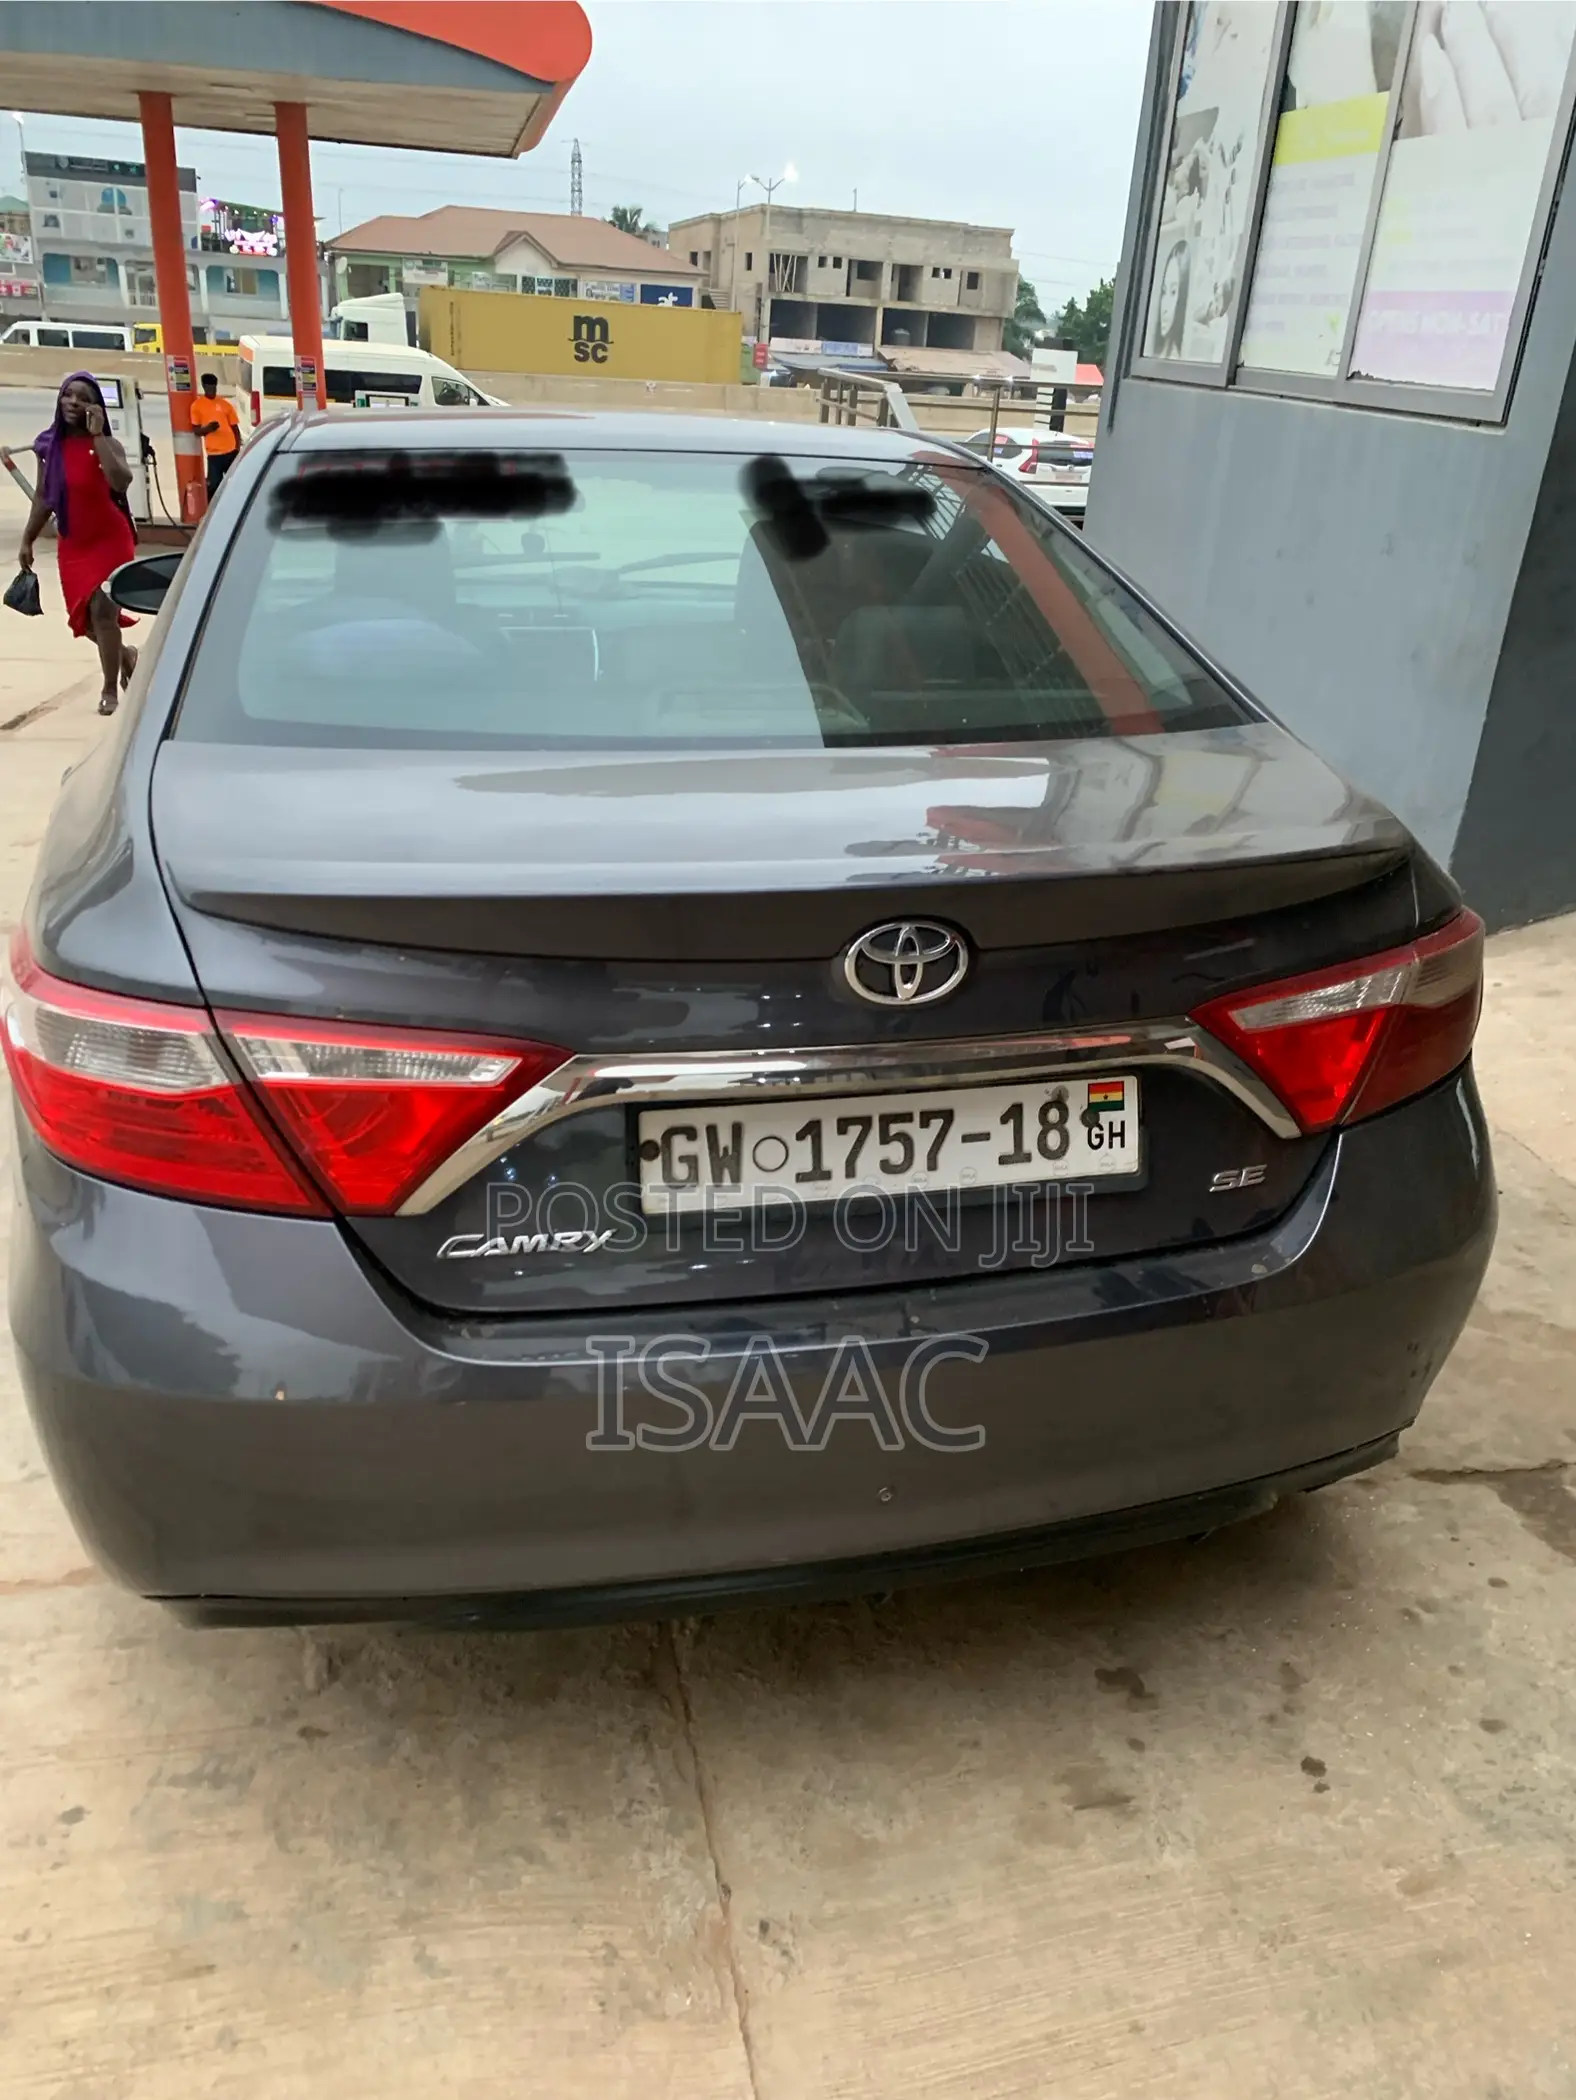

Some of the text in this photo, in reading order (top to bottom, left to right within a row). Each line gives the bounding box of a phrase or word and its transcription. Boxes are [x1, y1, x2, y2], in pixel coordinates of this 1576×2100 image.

[660, 1101, 1071, 1189] GW 1757-18
[1086, 1119, 1126, 1151] GH
[1209, 1164, 1267, 1192] SE
[436, 1228, 617, 1259] CAMRY
